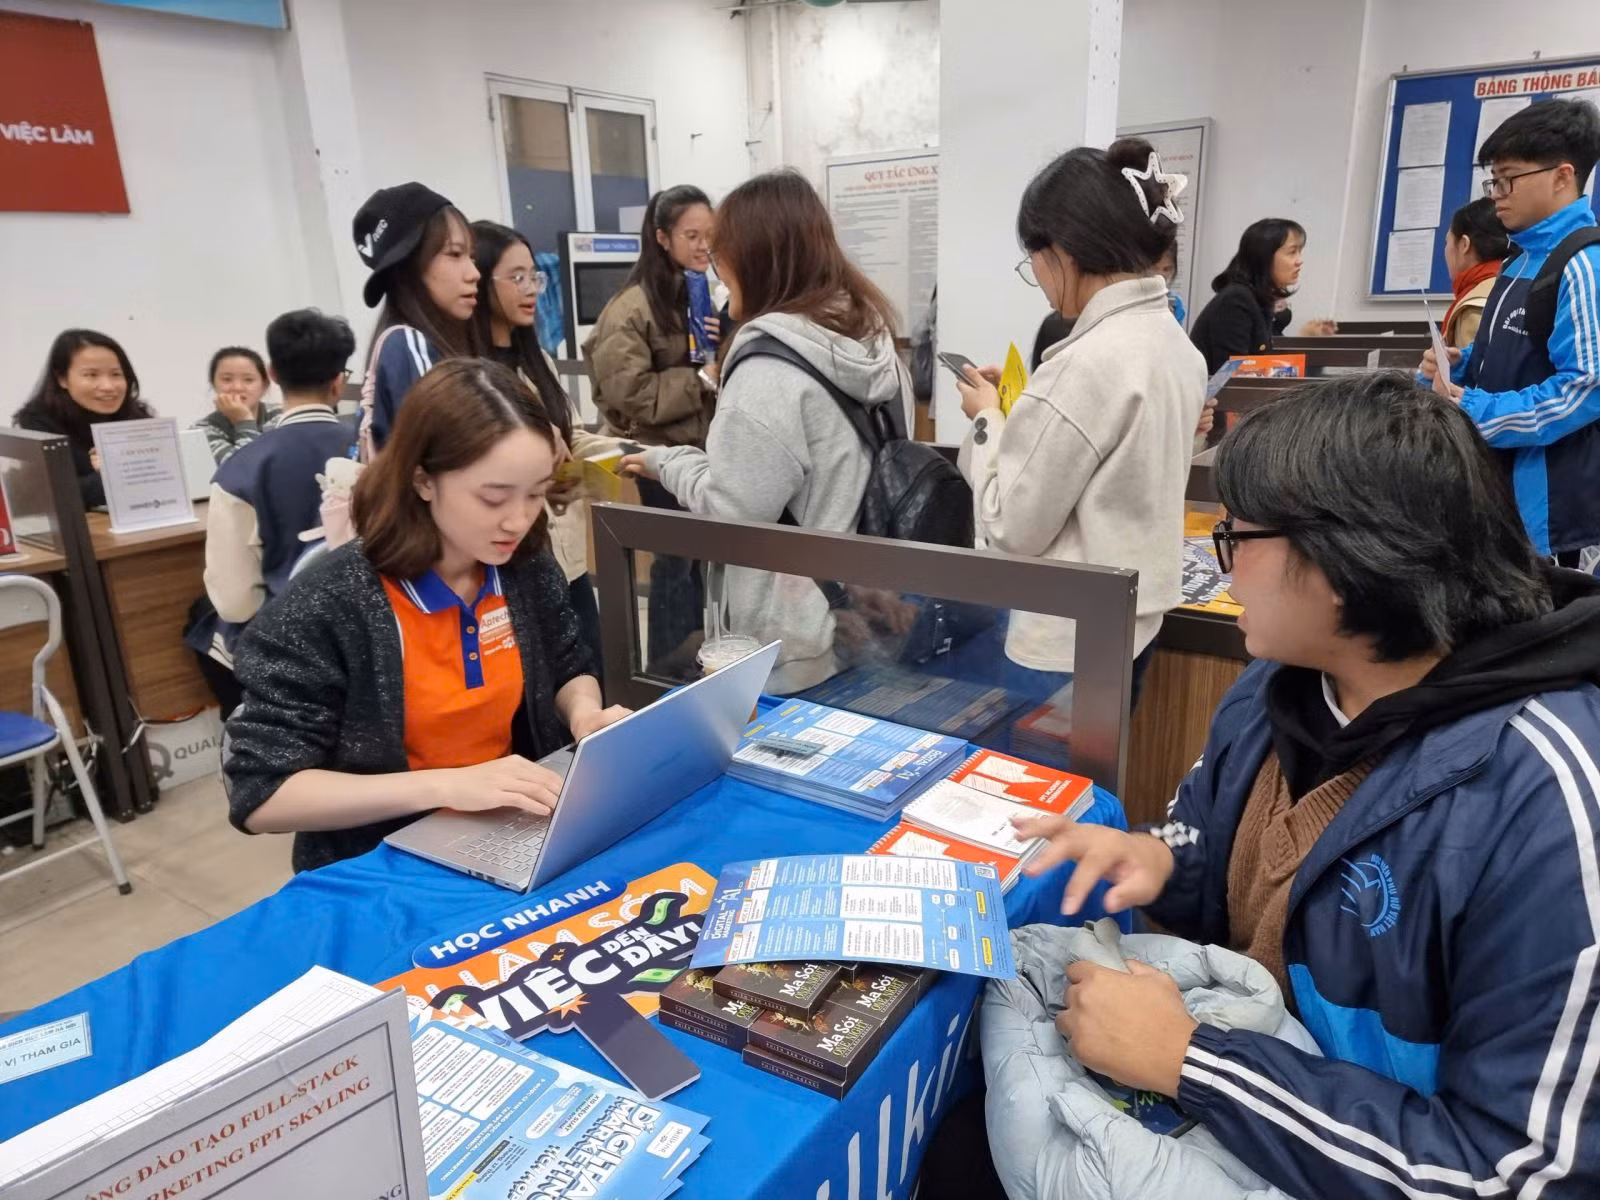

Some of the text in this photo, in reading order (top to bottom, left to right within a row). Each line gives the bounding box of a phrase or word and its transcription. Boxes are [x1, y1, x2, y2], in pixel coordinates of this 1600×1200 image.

[1476, 75, 1518, 96] BẢNG
[1576, 67, 1600, 87] BÁ
[0, 121, 94, 145] VIỆC LÀM
[430, 880, 611, 959] HỌC NHANH
[601, 925, 651, 954] ĐẾN
[618, 921, 701, 968] ĐÂY!
[779, 963, 819, 997] Ma Sói
[855, 974, 895, 1008] Ma Sói
[20, 1044, 56, 1062] THAM
[59, 1037, 81, 1050] GIA
[816, 1016, 859, 1053] Ma Sói
[137, 1149, 186, 1182] ĐÀO
[190, 1122, 236, 1150] TẠO
[240, 1054, 359, 1129] FULL-STACK
[249, 1124, 285, 1154] FPT
[289, 1076, 371, 1132] SKYLING
[556, 1102, 662, 1200] DIGITA
